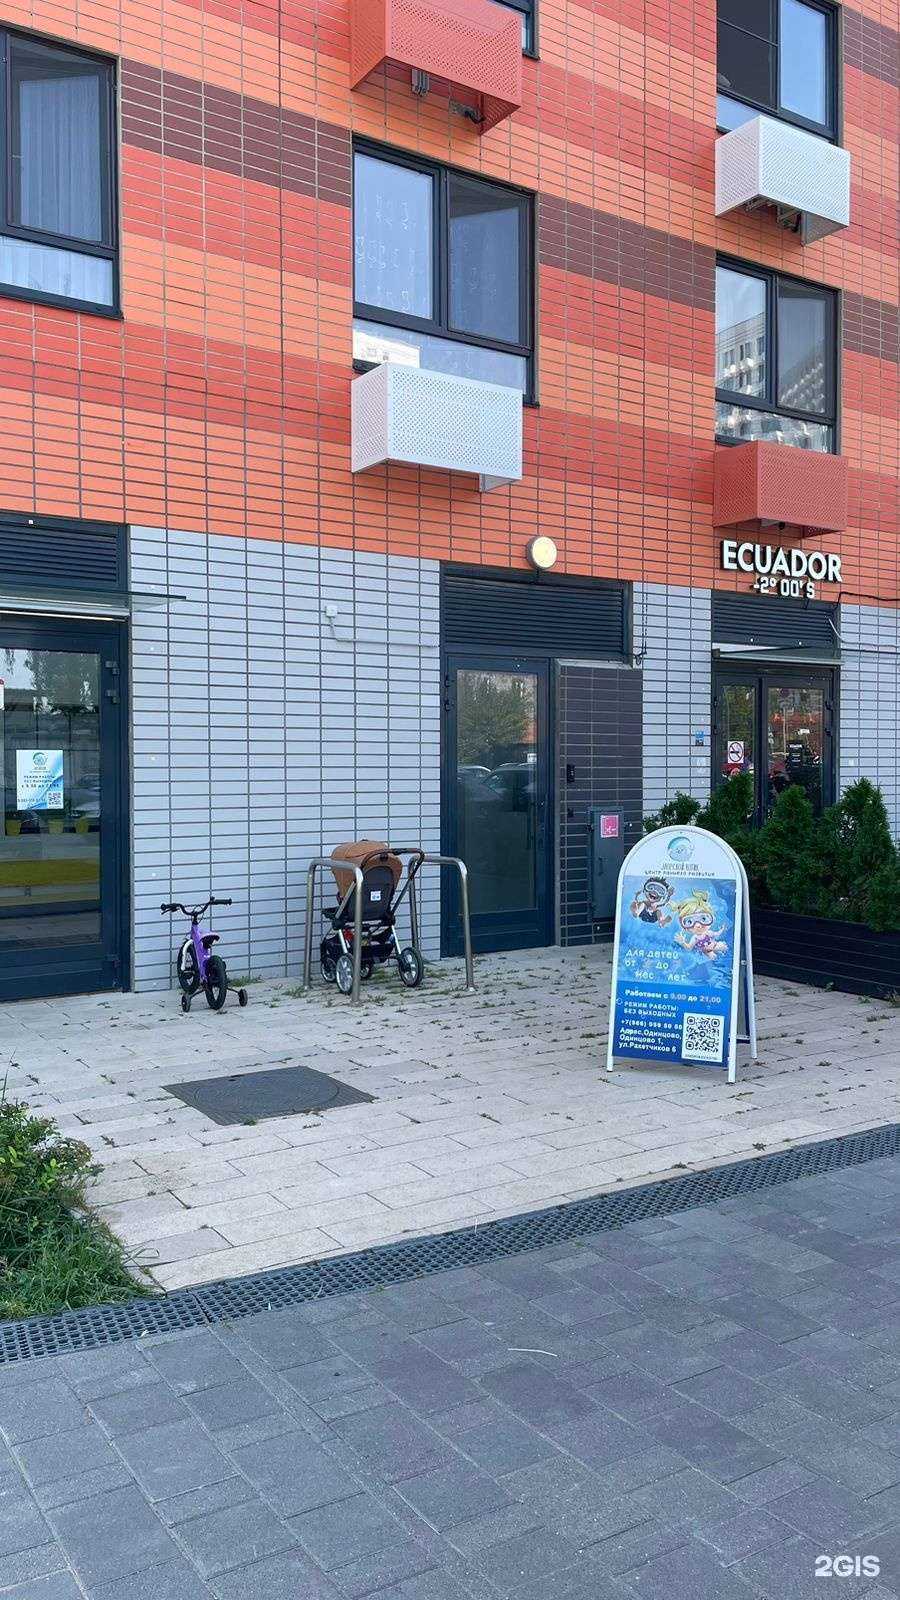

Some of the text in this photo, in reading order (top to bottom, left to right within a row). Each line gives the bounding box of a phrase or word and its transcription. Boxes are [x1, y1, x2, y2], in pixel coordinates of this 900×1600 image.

[723, 539, 843, 582] ECUADOR
[624, 989, 662, 999] Работаем
[699, 995, 721, 1003] 21.00
[637, 1009, 677, 1018] ВЫХОДНЫХ
[619, 1033, 656, 1044] Одинцово
